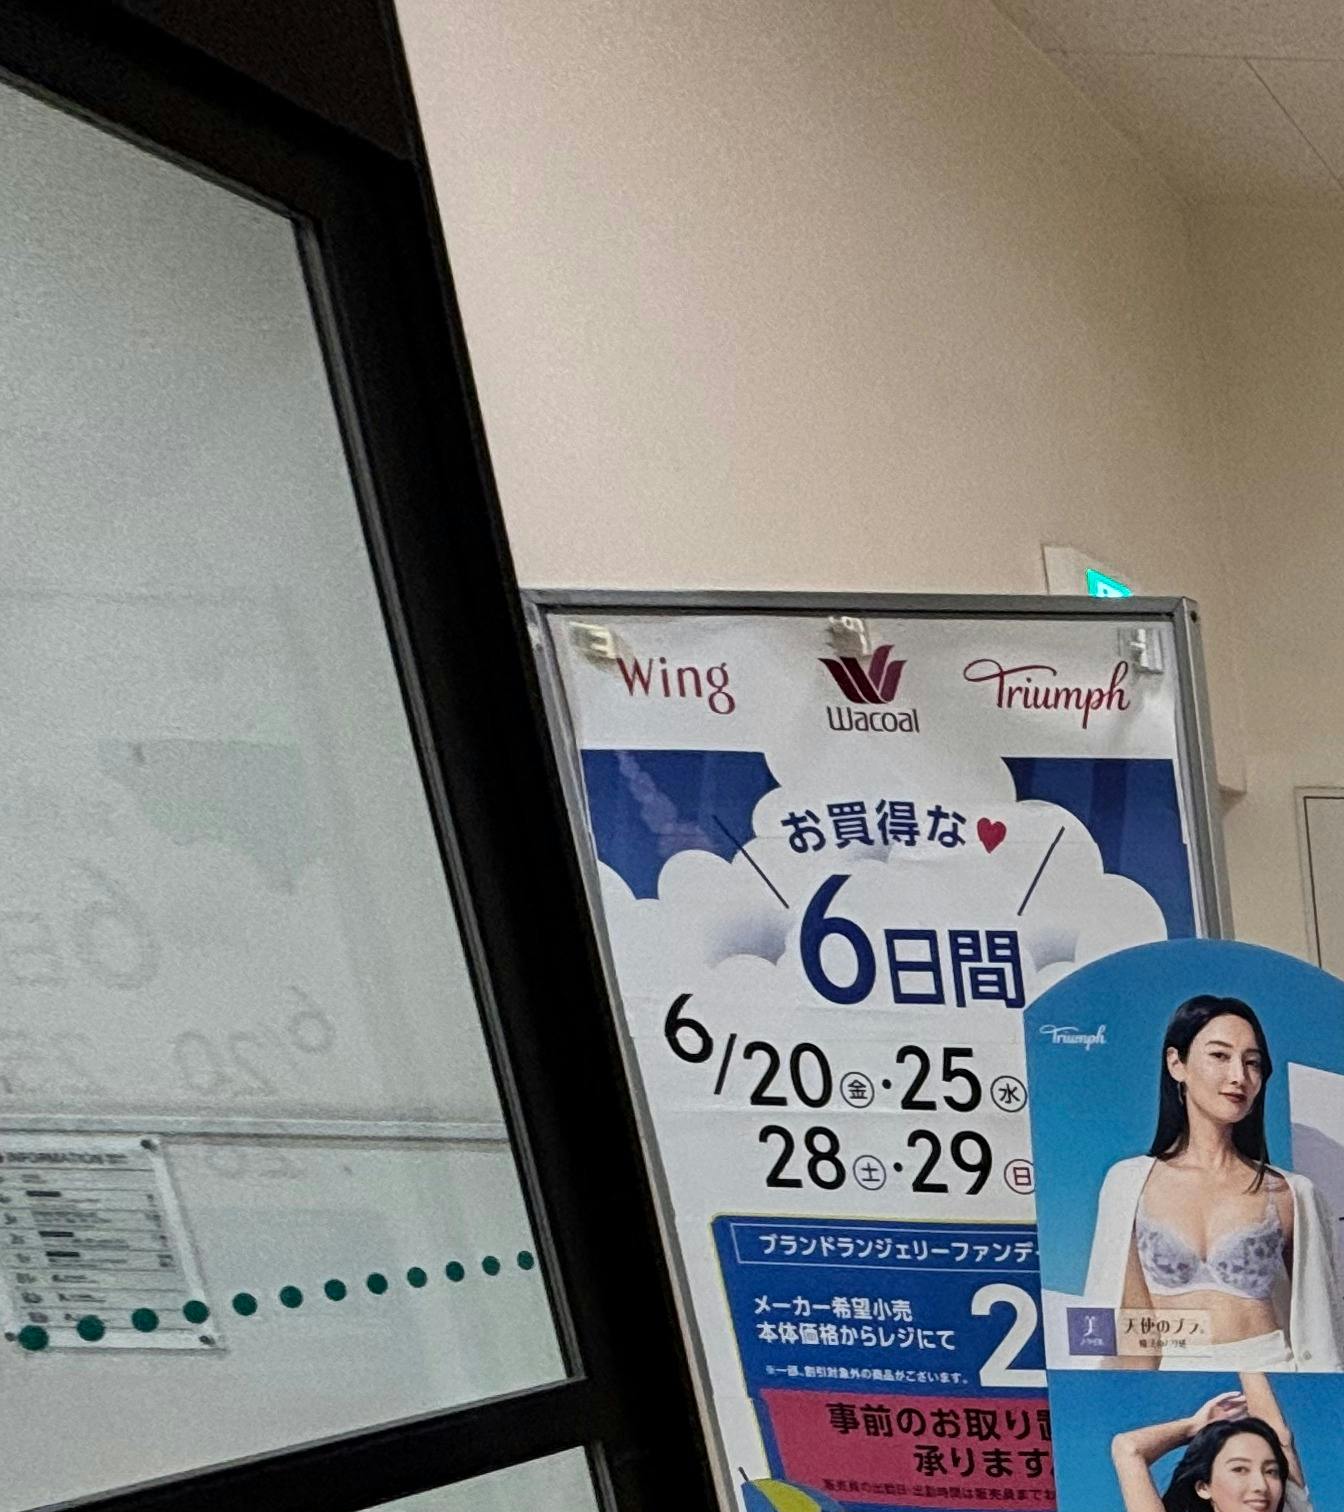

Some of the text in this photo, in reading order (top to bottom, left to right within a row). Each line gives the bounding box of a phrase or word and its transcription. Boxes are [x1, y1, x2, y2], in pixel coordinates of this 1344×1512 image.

[617, 656, 736, 715] Wing
[963, 659, 1131, 730] Triumph
[826, 706, 920, 733] Wacoal
[780, 799, 967, 854] お買得な
[799, 873, 1027, 1009] 6日間
[1040, 1024, 1107, 1051] Triumph
[758, 1233, 1040, 1264] ブランドランジェリーファンデ
[754, 1295, 913, 1322] メーカー希望小売
[756, 1322, 956, 1351] 本体価格からレジにて
[913, 1444, 1056, 1478] 承ります
